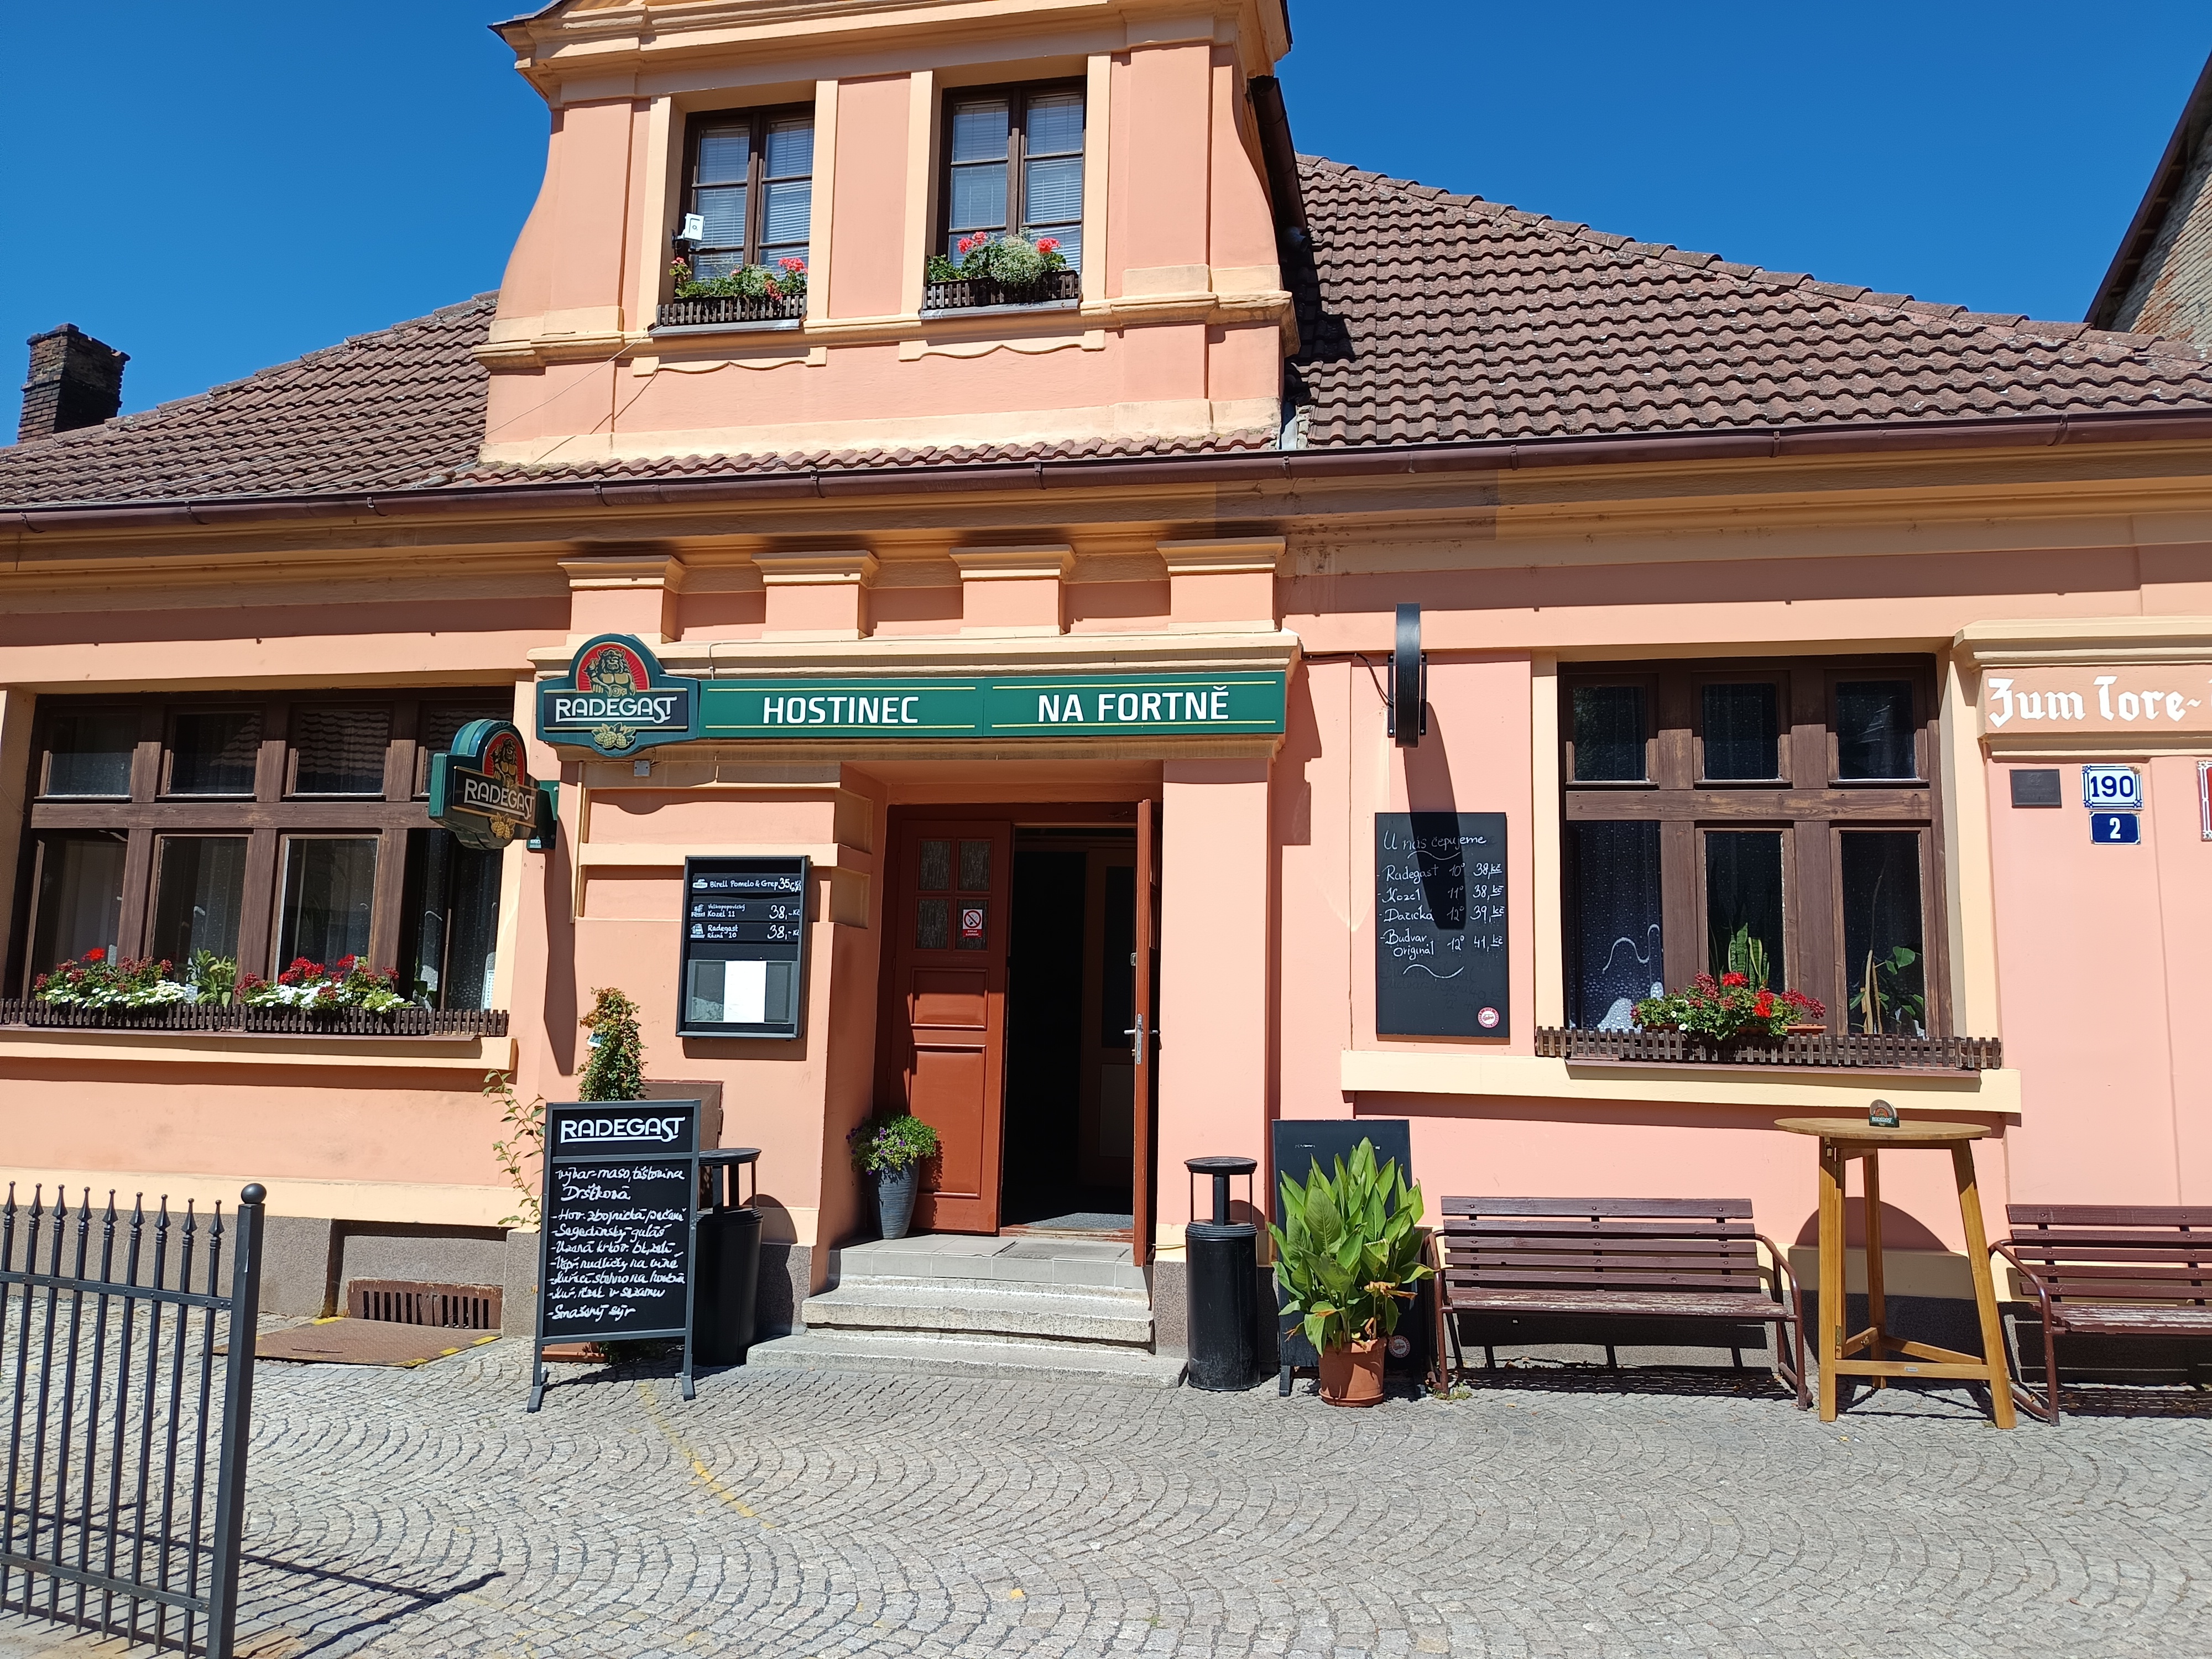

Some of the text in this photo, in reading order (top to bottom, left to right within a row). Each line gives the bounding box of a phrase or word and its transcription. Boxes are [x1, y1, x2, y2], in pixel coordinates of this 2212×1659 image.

[555, 696, 677, 724] RADEGAST
[763, 685, 1230, 724] HOSTINEC NA FORTNĚ
[1988, 677, 2086, 728] Zum
[2090, 775, 2135, 797] 190
[463, 778, 535, 820] RADEGAST
[2109, 817, 2121, 839] 2
[1384, 830, 1487, 851] U nás čepujeme
[709, 880, 728, 888] Birell
[761, 880, 779, 891] Grep
[708, 903, 745, 912] Velkopopovický
[707, 924, 739, 935] Radegast
[560, 1117, 686, 1143] RADEGAST
[629, 1259, 648, 1267] na
